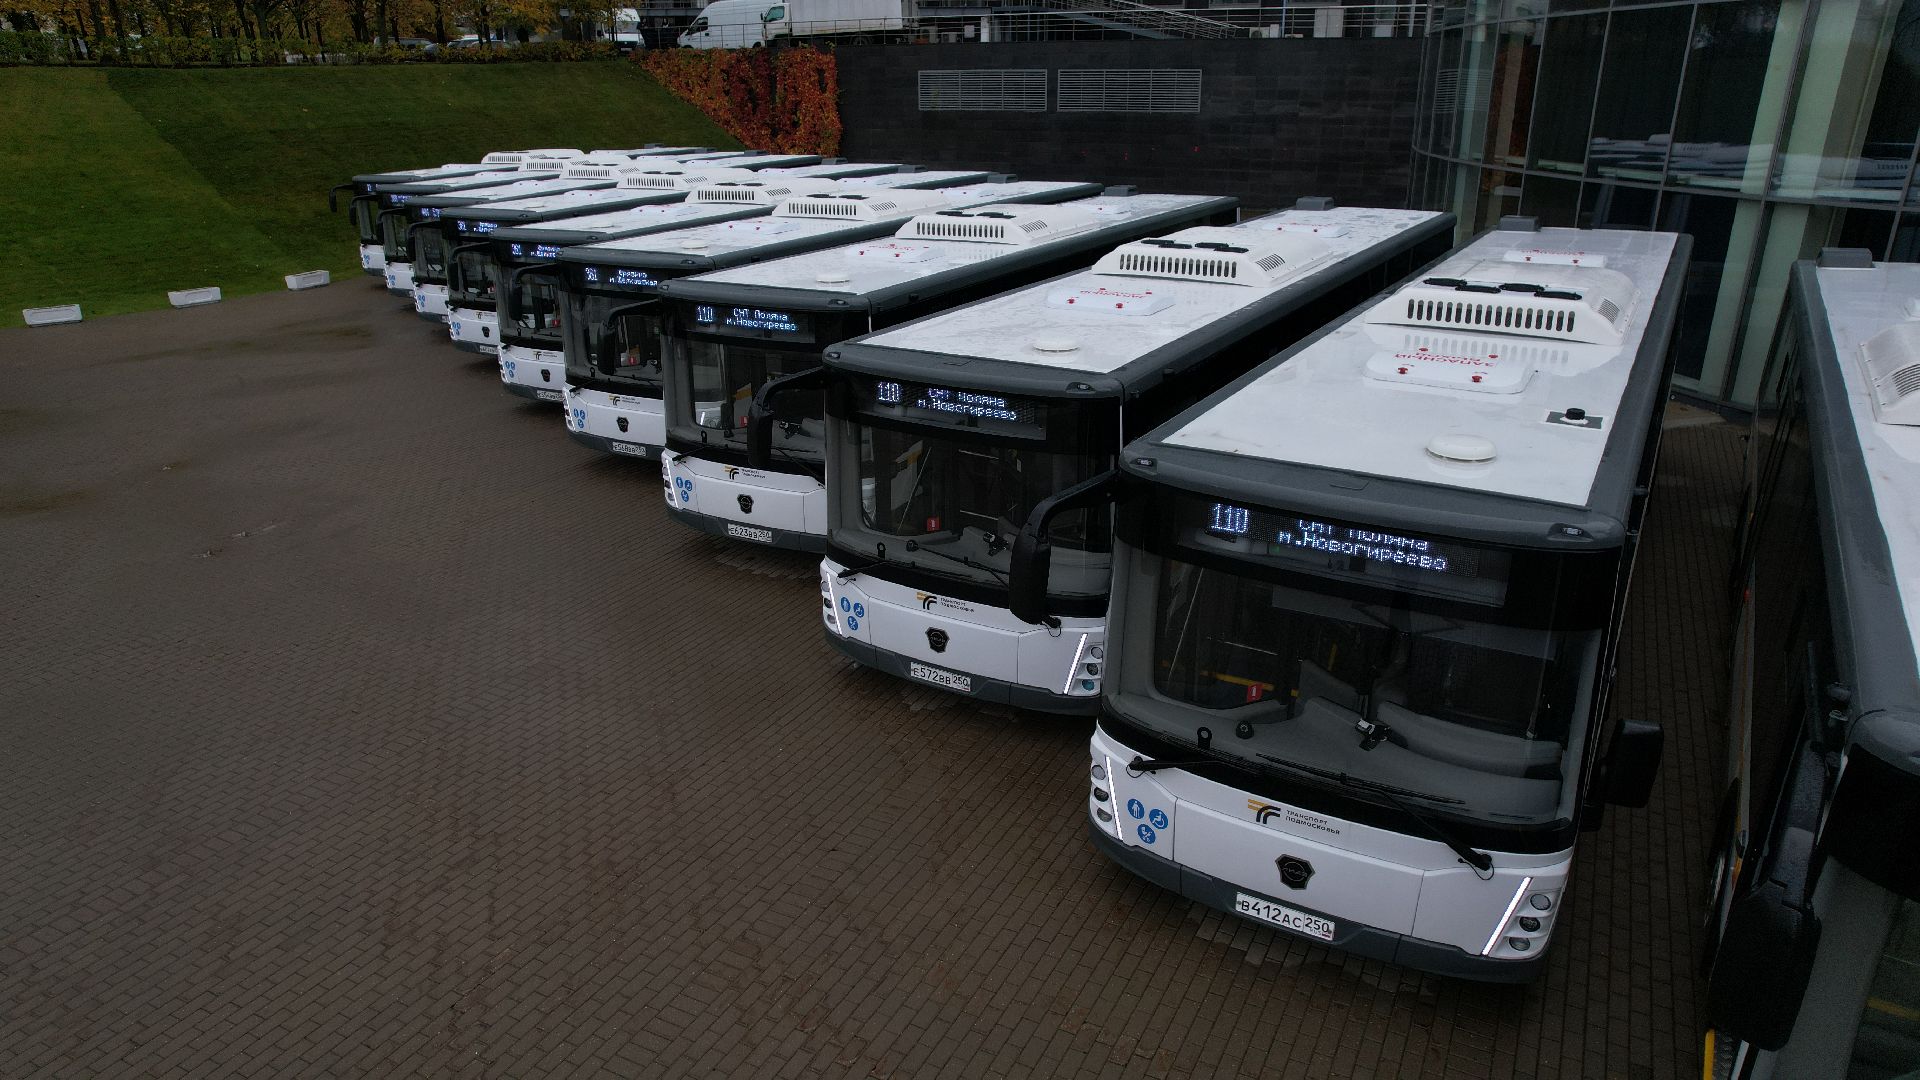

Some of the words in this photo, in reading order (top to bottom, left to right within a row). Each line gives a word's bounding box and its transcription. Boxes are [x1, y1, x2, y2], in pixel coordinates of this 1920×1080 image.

[697, 305, 713, 322] 110
[733, 307, 749, 317] СНТ
[877, 381, 900, 402] 110
[917, 398, 1017, 421] м.Новогиреево
[1211, 503, 1248, 533] 110
[1278, 531, 1448, 571] м.Новогиреево
[913, 667, 951, 685] Е572ВВ
[953, 675, 969, 687] 250
[1285, 815, 1341, 835] ПОДМОСКОВЬЯ
[1286, 809, 1328, 825] ТРАНСПОРТ
[1241, 900, 1302, 928] В412АС
[1304, 917, 1330, 933] 250
